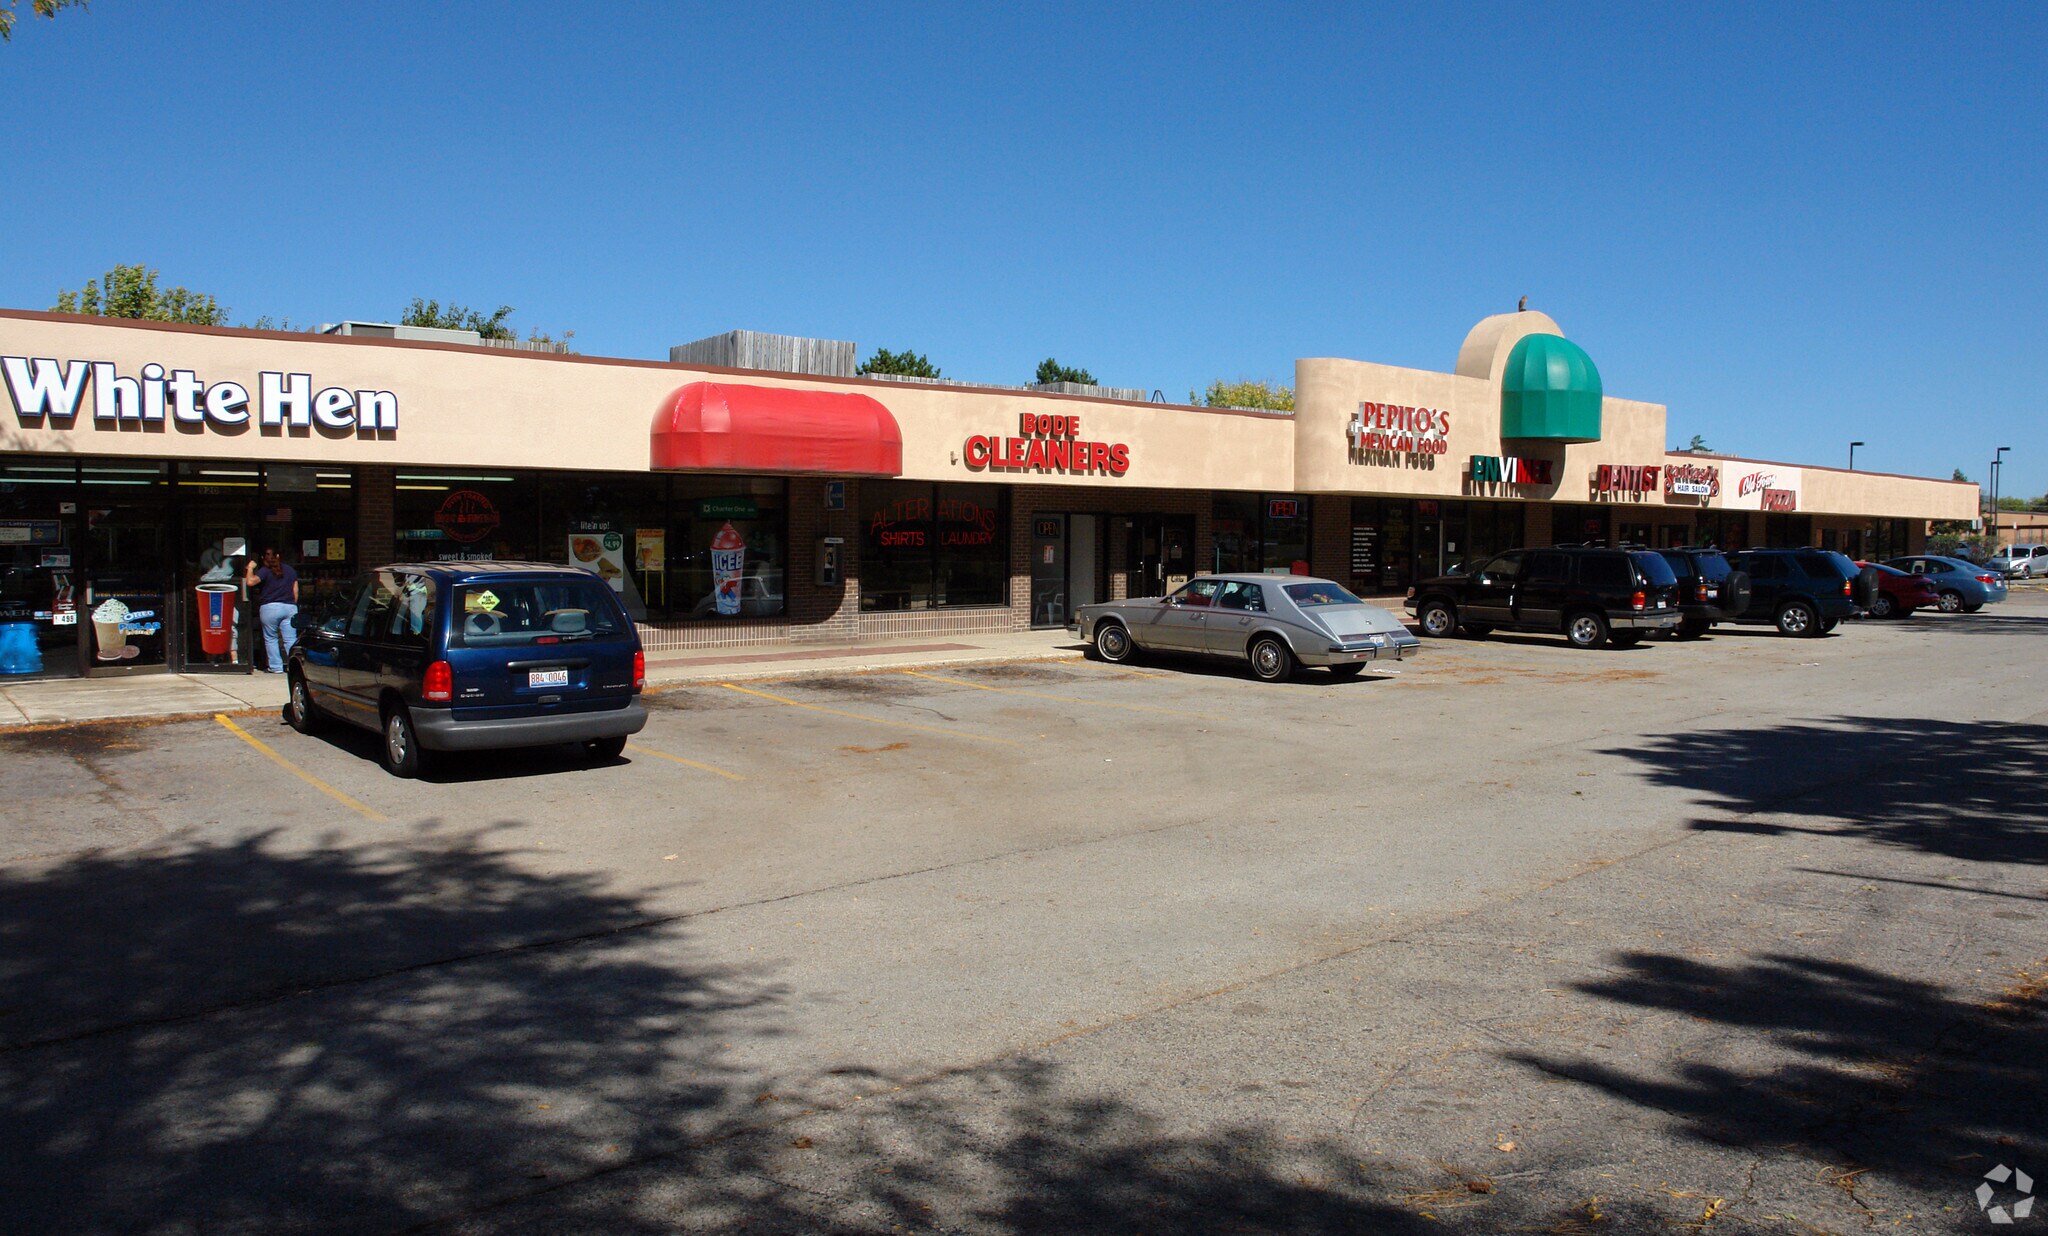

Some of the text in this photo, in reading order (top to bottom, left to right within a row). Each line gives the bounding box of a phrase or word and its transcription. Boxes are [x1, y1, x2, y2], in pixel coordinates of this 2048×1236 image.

[1, 355, 398, 430] White Hen
[1022, 412, 1079, 436] BODE
[1364, 402, 1450, 436] PEPITO'S
[1360, 432, 1447, 455] MEXICAN FOOD
[965, 434, 1130, 473] CLEANERS
[1472, 455, 1553, 485] ENVIMEX
[1599, 464, 1662, 492] DENTIST
[1677, 484, 1709, 494] HAIR SALON
[1762, 489, 1796, 511] PIZZA
[1271, 502, 1297, 516] OPEN
[599, 521, 610, 532] up!
[1039, 521, 1059, 536] OPEN
[880, 530, 995, 546] SHIRTS LAUNDRY
[438, 552, 493, 561] sweet & smoked
[714, 553, 743, 572] ICEE
[123, 610, 154, 621] OREO
[119, 621, 162, 632] POLAR
[531, 671, 567, 684] 884 0046
